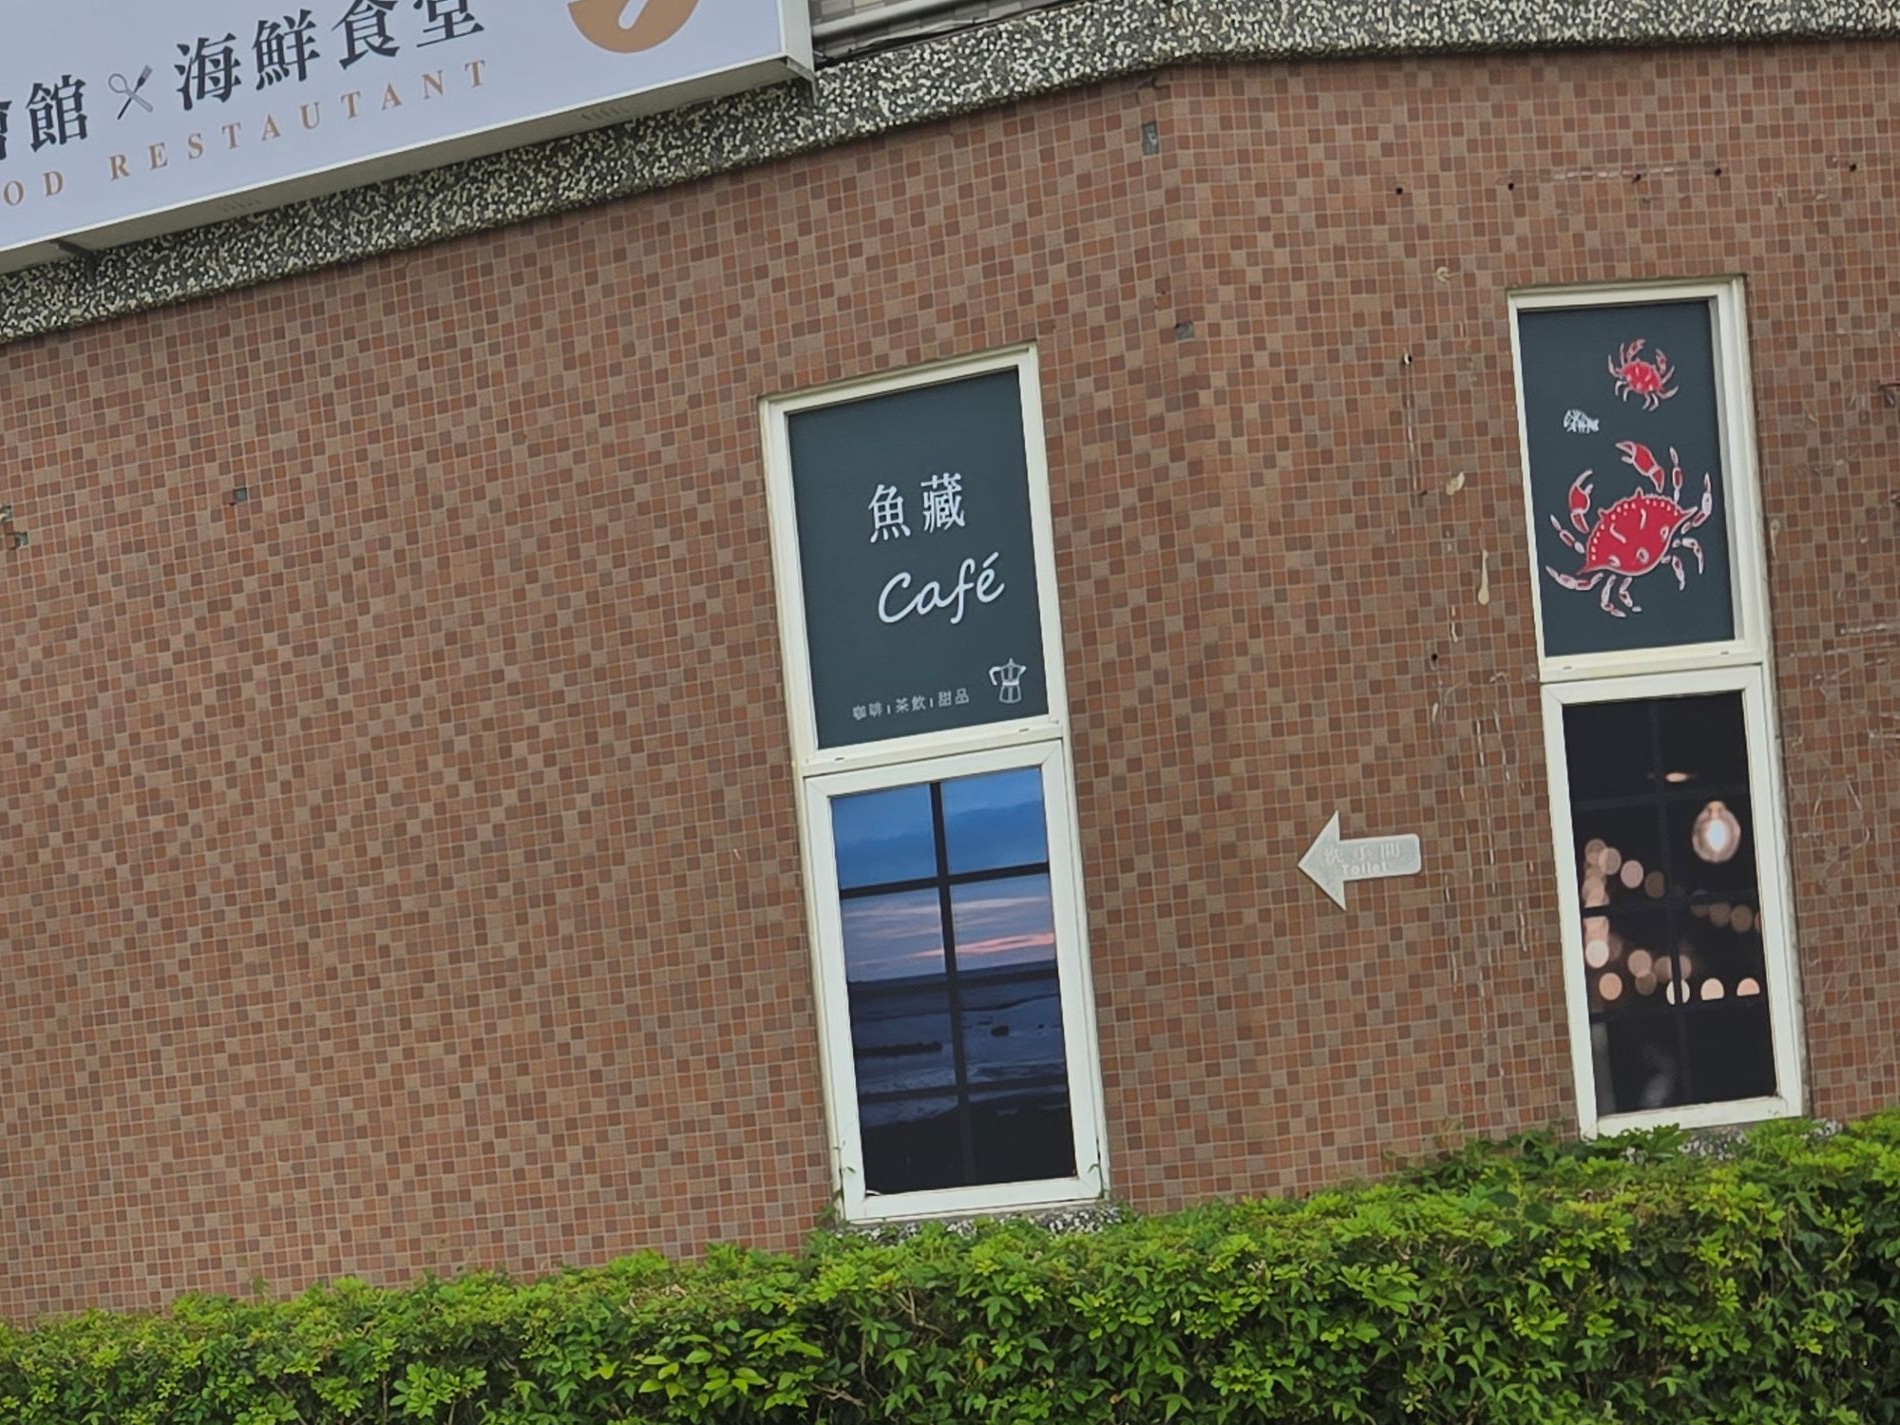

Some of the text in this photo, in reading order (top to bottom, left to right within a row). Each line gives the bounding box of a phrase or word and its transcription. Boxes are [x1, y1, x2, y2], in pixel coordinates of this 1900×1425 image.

[108, 59, 487, 181] RESTAUTANT
[866, 472, 967, 543] 魚藏
[877, 551, 1005, 625] Café
[1341, 860, 1388, 877] Toilet
